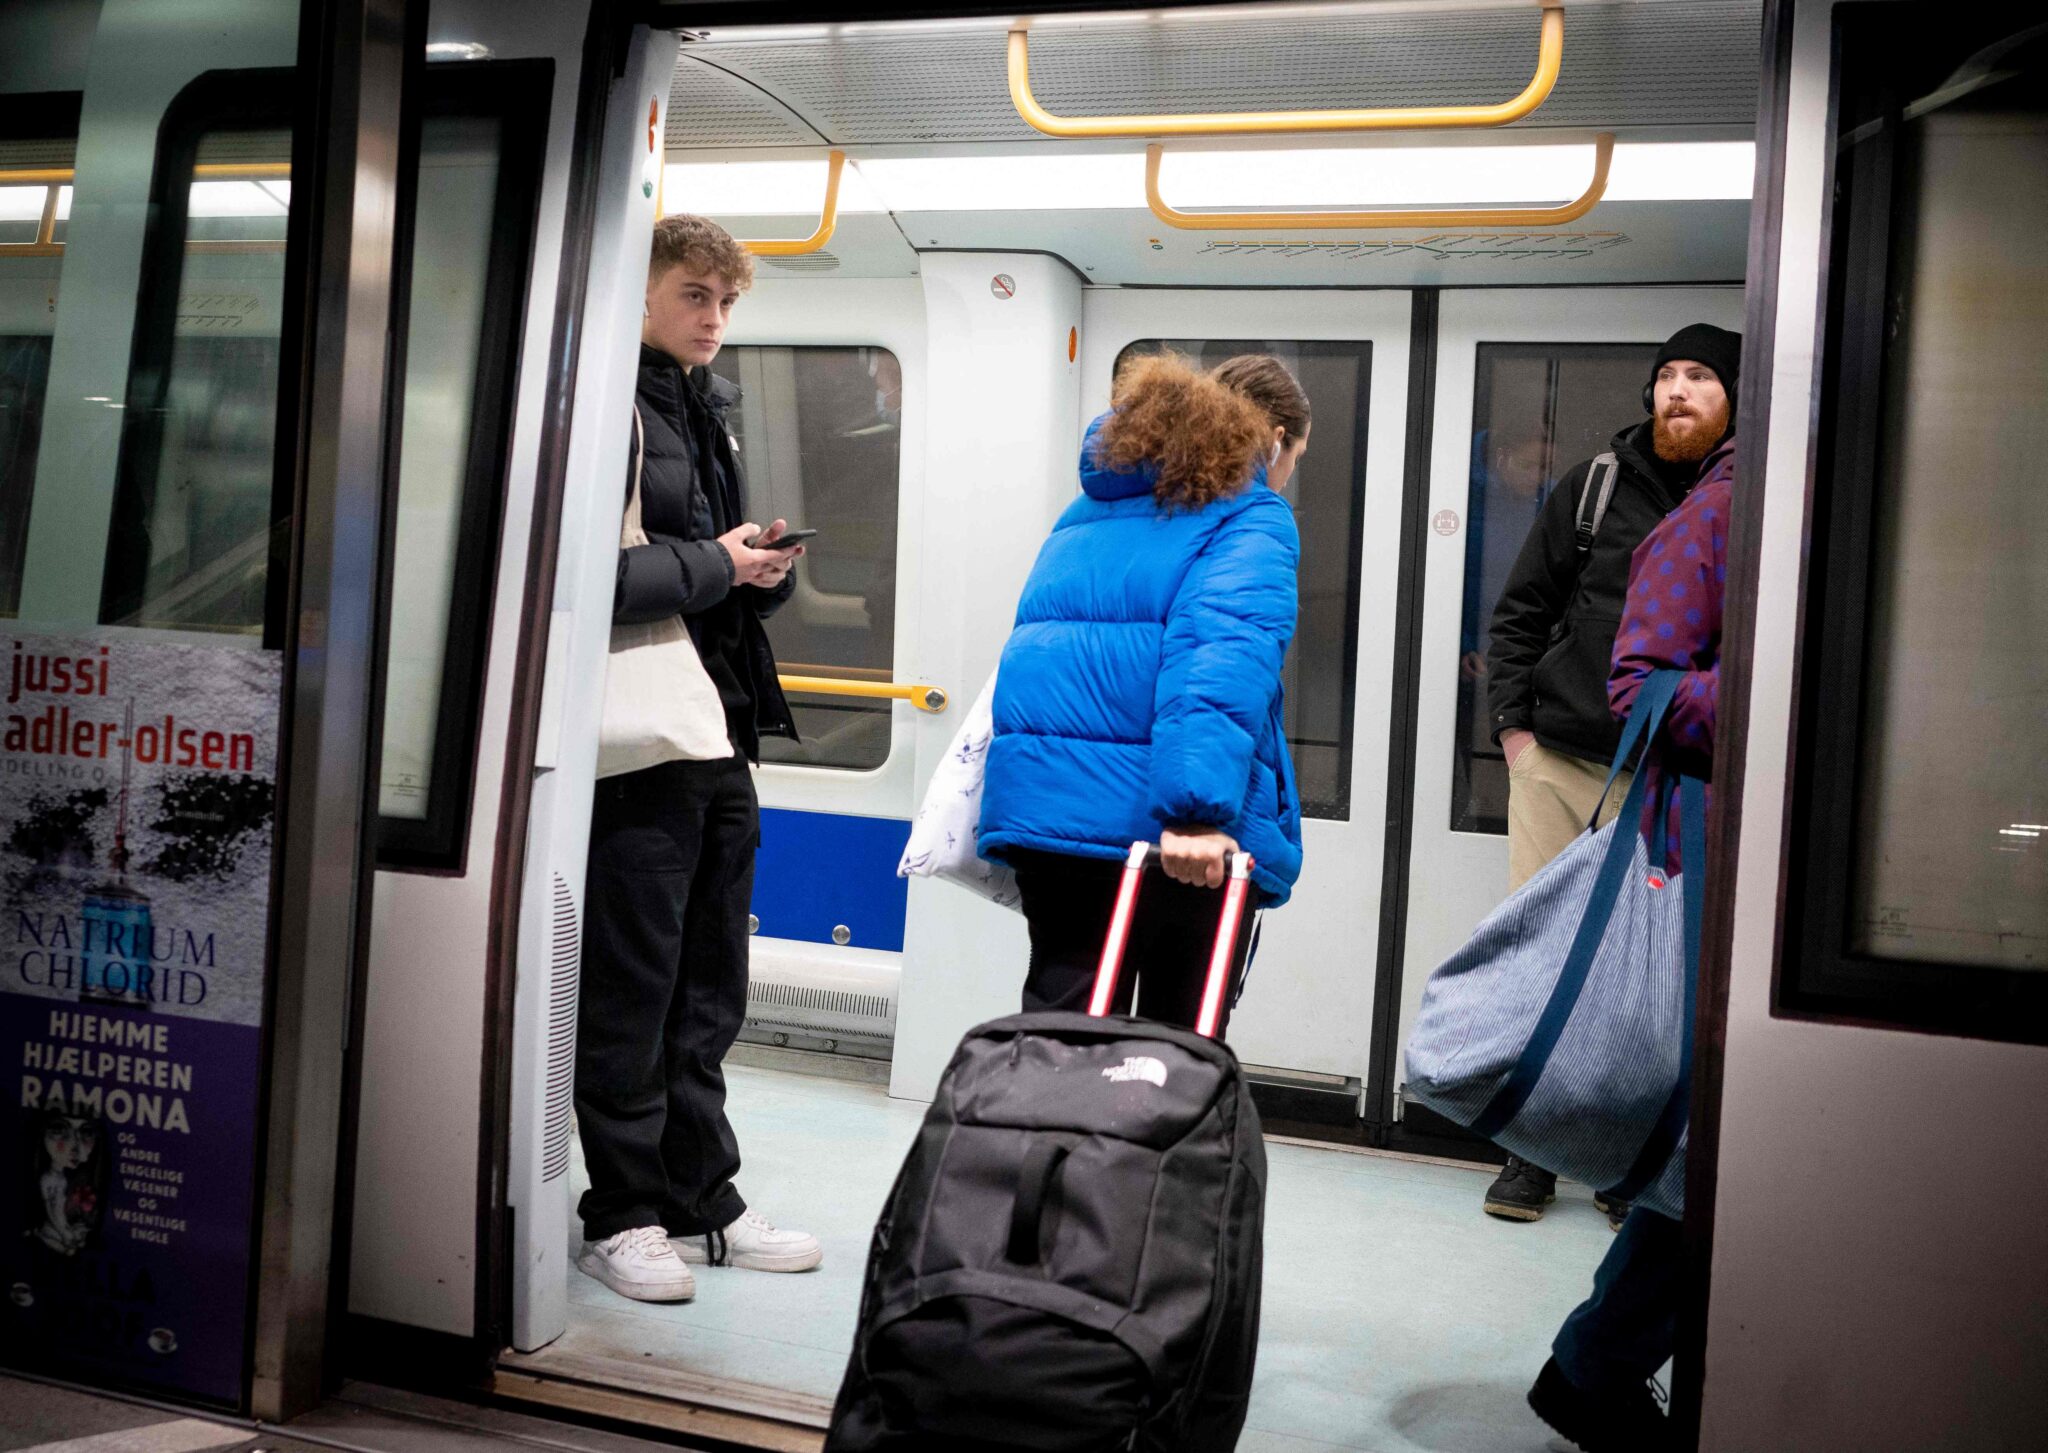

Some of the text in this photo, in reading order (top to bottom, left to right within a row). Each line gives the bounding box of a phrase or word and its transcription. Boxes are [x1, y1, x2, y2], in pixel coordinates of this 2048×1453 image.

[7, 641, 109, 703] jussi
[4, 705, 254, 771] adler-olsen
[0, 758, 84, 780] DELING
[16, 909, 216, 967] NATRIUM
[19, 950, 207, 1006] CHLORID
[49, 1010, 169, 1053] HJEMME
[24, 1041, 192, 1092] HJÆLPEREN
[21, 1075, 191, 1134] RAMONA
[117, 1131, 137, 1145] OG
[120, 1147, 161, 1164] ANDRE
[137, 1197, 158, 1210] OG
[131, 1227, 169, 1245] ENGLE
